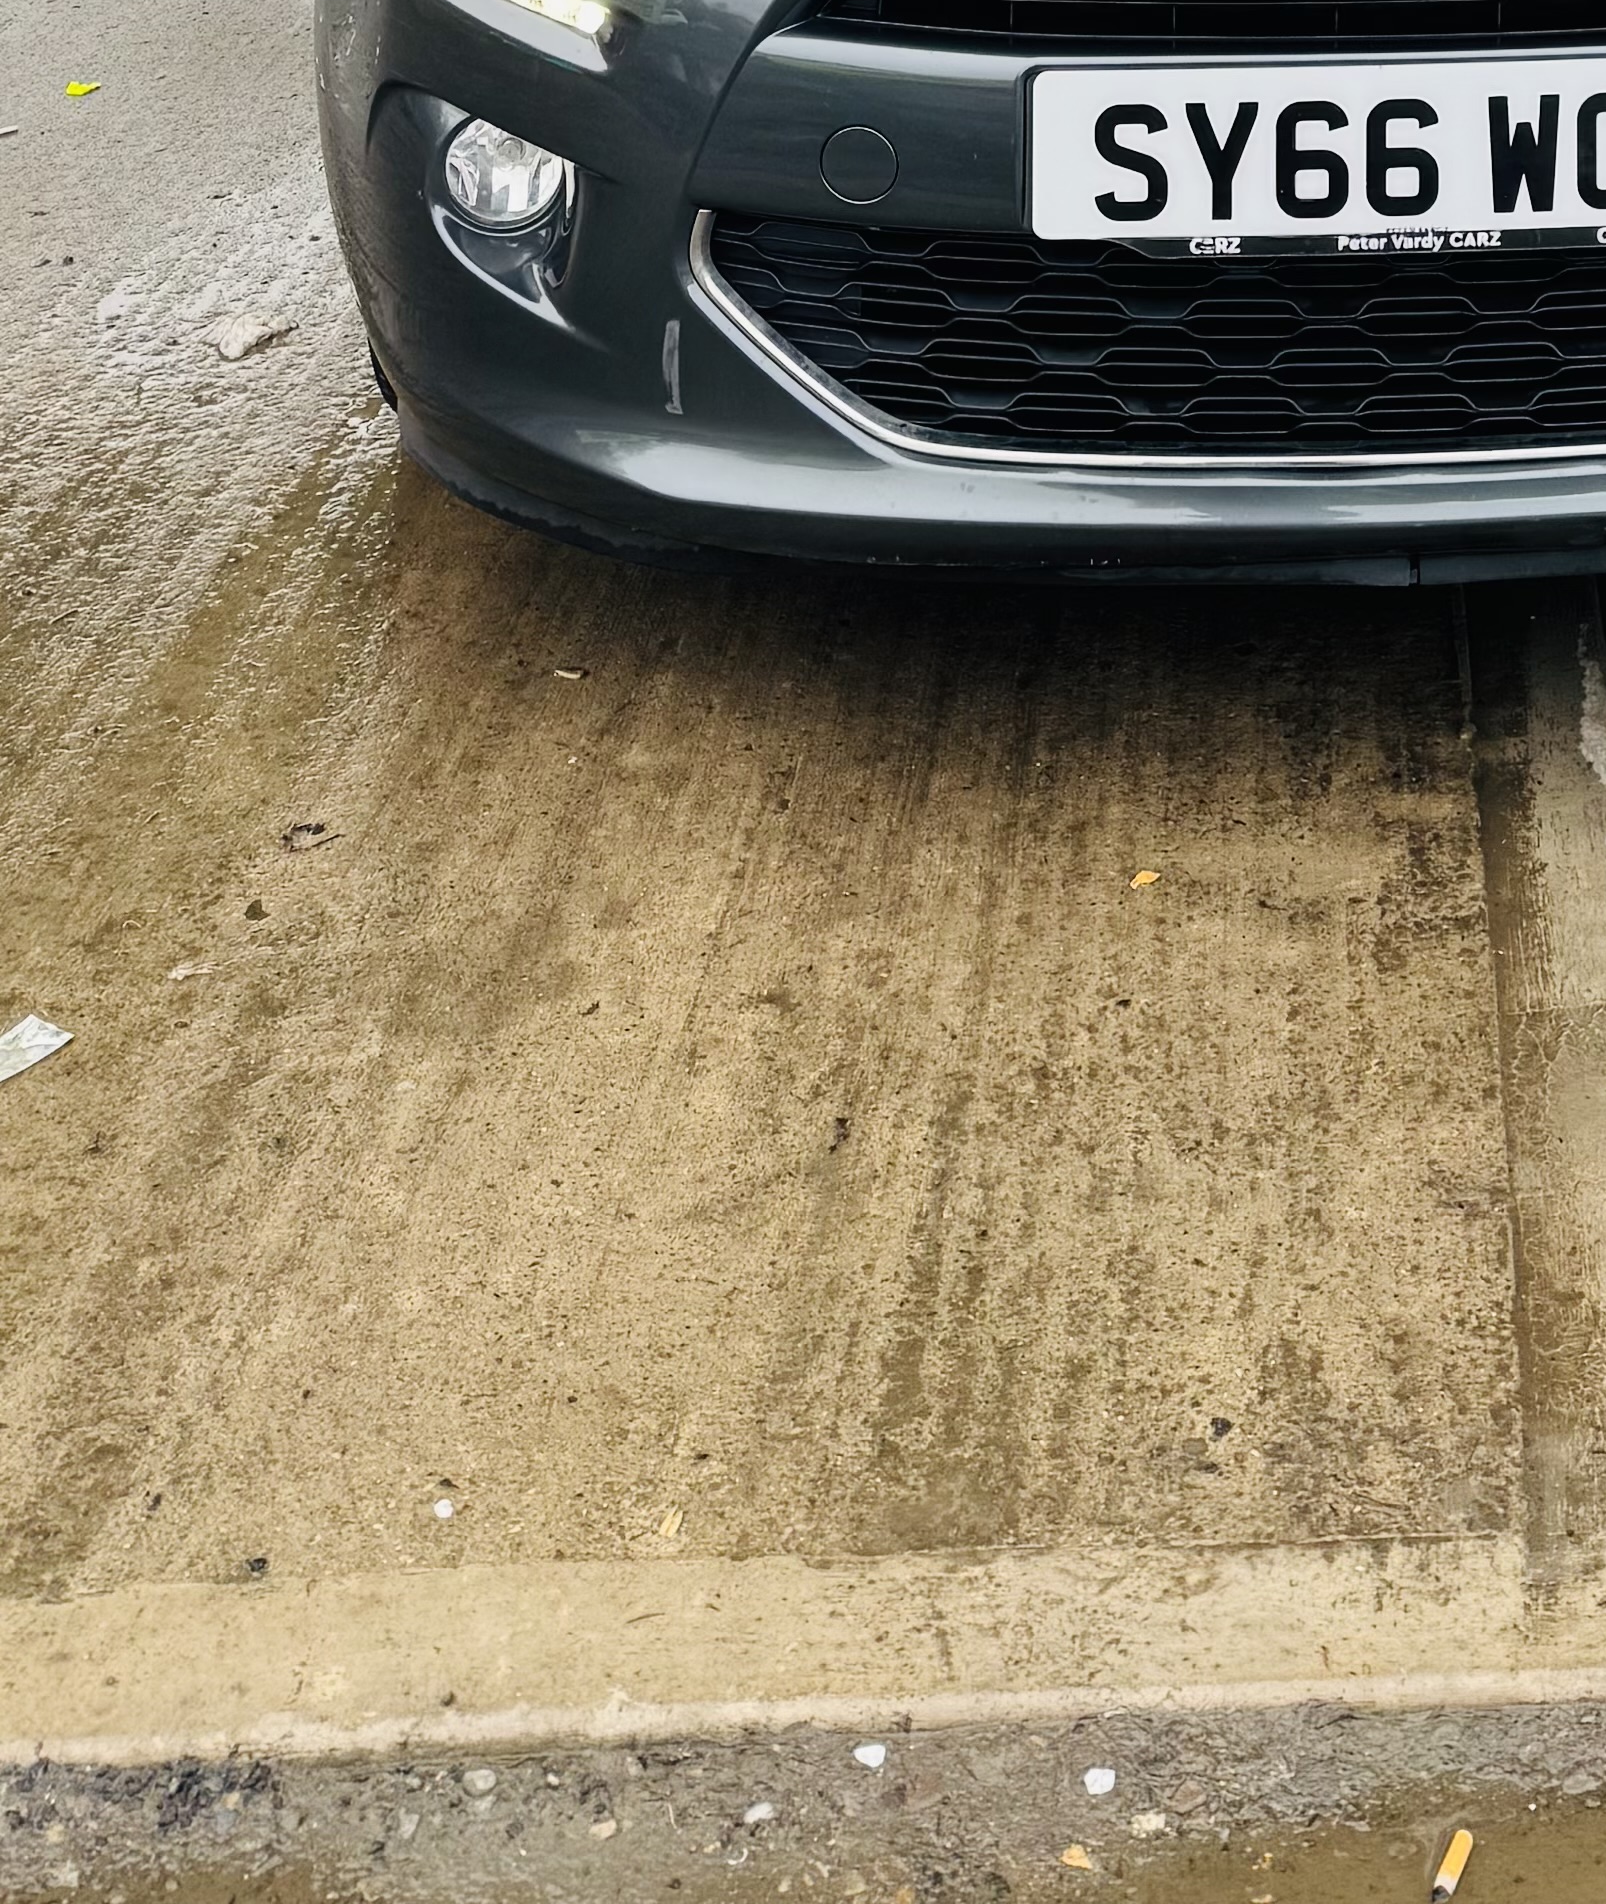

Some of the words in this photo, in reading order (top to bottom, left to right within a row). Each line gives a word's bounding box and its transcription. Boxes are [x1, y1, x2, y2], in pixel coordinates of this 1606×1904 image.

[1094, 99, 1439, 222] SY66
[1336, 235, 1388, 252] Peter
[1390, 231, 1445, 253] Vardy
[1449, 230, 1502, 248] CARZ
